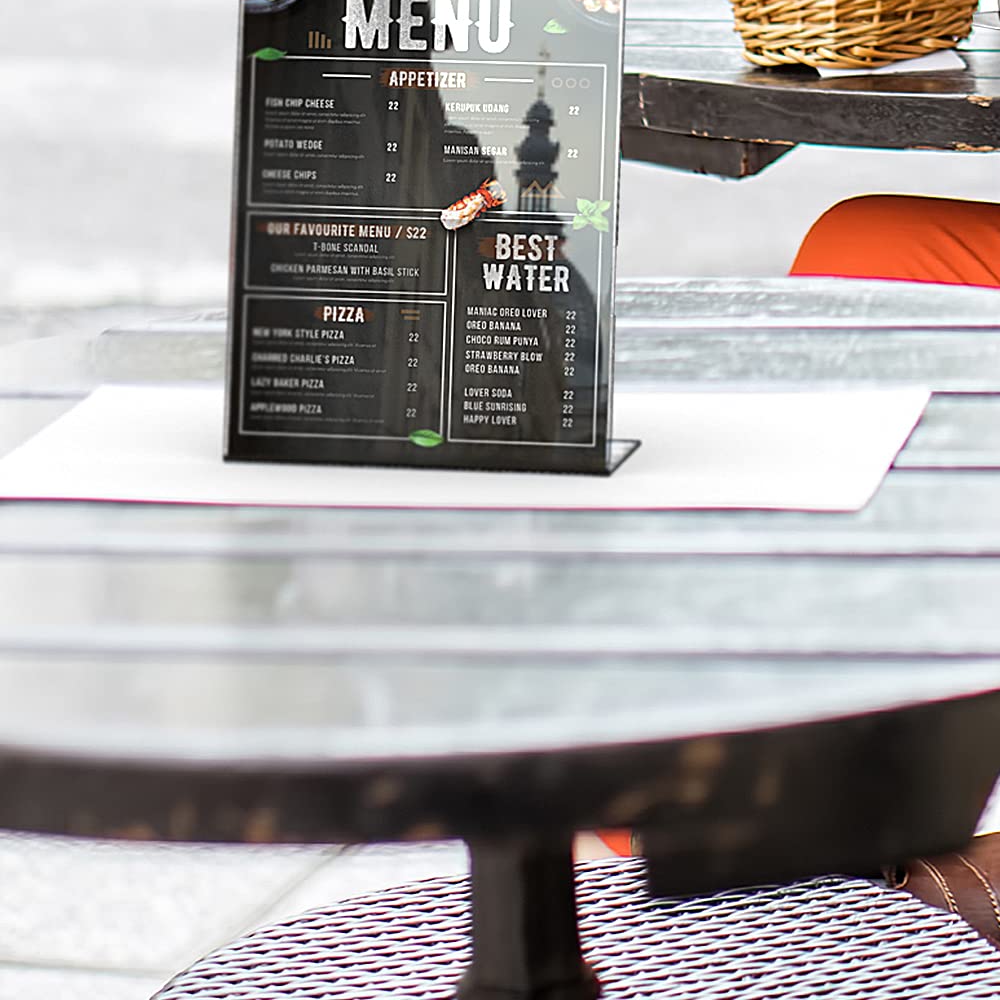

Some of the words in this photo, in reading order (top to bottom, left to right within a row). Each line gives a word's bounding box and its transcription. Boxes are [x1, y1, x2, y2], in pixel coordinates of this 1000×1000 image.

[389, 70, 467, 89] APPETIZER
[285, 98, 303, 108] CHIP
[305, 99, 335, 109] CHEESE
[388, 101, 399, 110] 22
[568, 106, 580, 115] 22
[264, 139, 294, 149] POTATO
[296, 140, 323, 150] WEDGE
[387, 142, 398, 152] 22
[443, 145, 479, 155] MANISAN
[567, 149, 579, 158] 22
[294, 171, 317, 180] CHIPS
[385, 173, 397, 182] 22
[267, 222, 290, 235] OUR
[293, 223, 355, 237] FAVOURITE
[358, 225, 391, 238] MENU
[394, 225, 403, 239] /
[313, 242, 341, 252] T-BONE
[343, 243, 379, 253] SCANDAL
[495, 233, 559, 261] BEST
[306, 264, 348, 275] PARMESAN
[350, 266, 370, 275] WITH
[372, 267, 395, 277] BASIL
[396, 268, 420, 277] STICK
[483, 263, 570, 292] WATER
[323, 305, 365, 323] PIZZA
[466, 306, 498, 316] MANIAC
[499, 307, 520, 317] OREO
[521, 308, 548, 318] LOVER
[565, 310, 576, 320] 22
[466, 320, 487, 330] OREO
[488, 321, 522, 331] BANANA
[565, 324, 576, 334] 22
[295, 329, 319, 339] STYLE
[321, 330, 345, 340] PIZZA
[408, 332, 420, 342] 22
[465, 335, 492, 345] CHOCO
[493, 336, 511, 346] RUM
[512, 337, 539, 347] PUNYA
[564, 338, 575, 348] 22
[331, 355, 355, 365] PIZZA
[407, 358, 418, 368] 22
[465, 350, 519, 361] STRAWBERRY
[520, 351, 543, 362] BLOW
[564, 352, 575, 362] 22
[464, 364, 486, 374] OREO
[487, 365, 520, 375] BANANA
[563, 366, 575, 377] 22
[301, 379, 325, 389] PIZZA
[407, 382, 418, 392] 22
[464, 387, 490, 397] LOVER
[491, 388, 513, 398] SODA
[563, 390, 574, 400] 22
[298, 404, 322, 414] PIZZA
[406, 408, 417, 418] 22
[463, 401, 483, 411] BLUE
[485, 402, 527, 413] SUNRISING
[562, 404, 573, 414] 22
[463, 414, 489, 425] HAPPY
[491, 415, 517, 426] LOVER
[562, 418, 573, 428] 22
